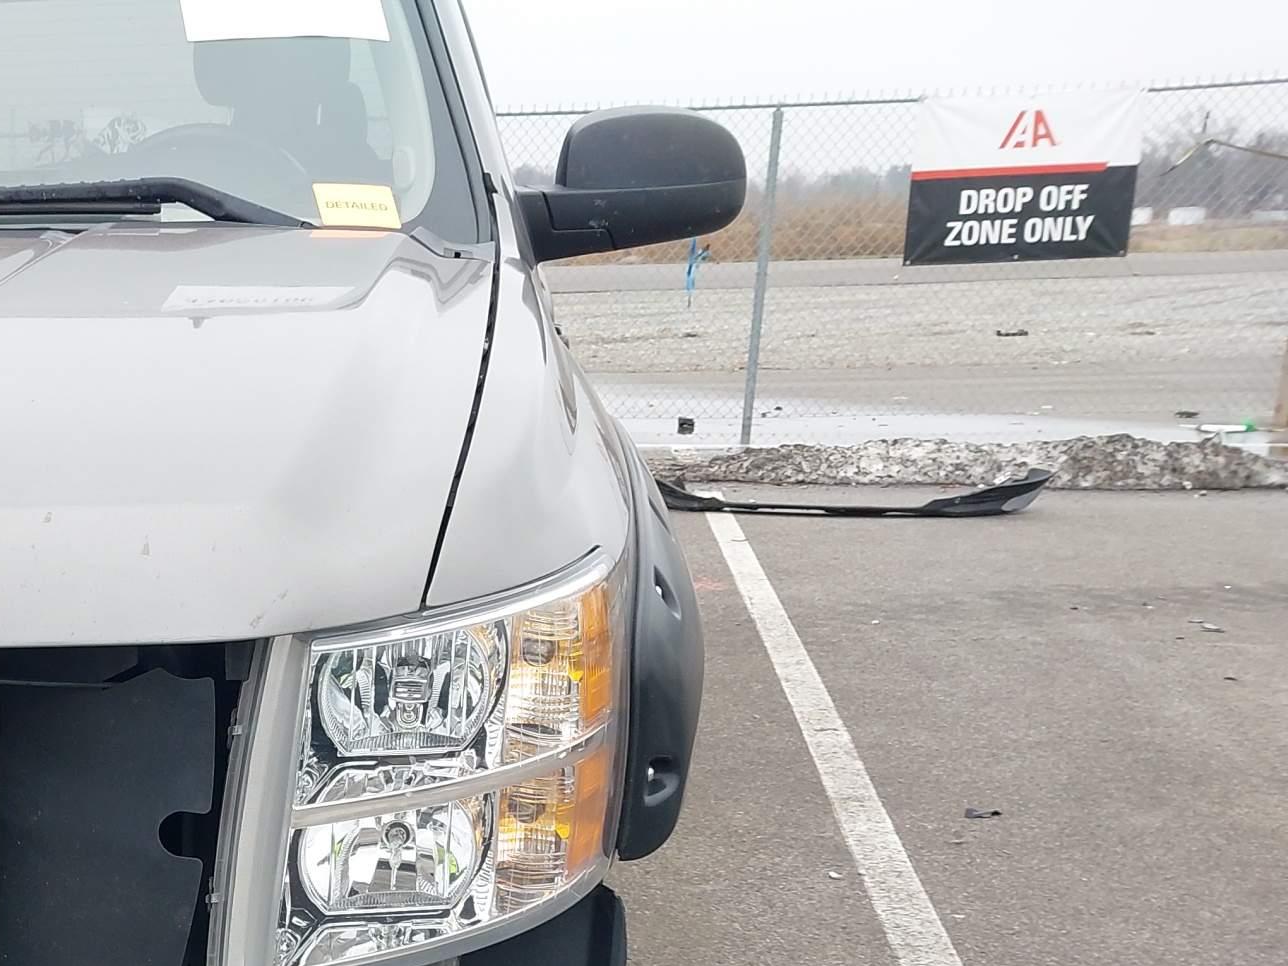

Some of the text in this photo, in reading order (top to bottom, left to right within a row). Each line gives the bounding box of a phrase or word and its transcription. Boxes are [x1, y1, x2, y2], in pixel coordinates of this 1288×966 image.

[325, 200, 389, 212] DETAILED
[958, 183, 1090, 215] DROP OFF
[943, 214, 1096, 246] ZONE ONLY
